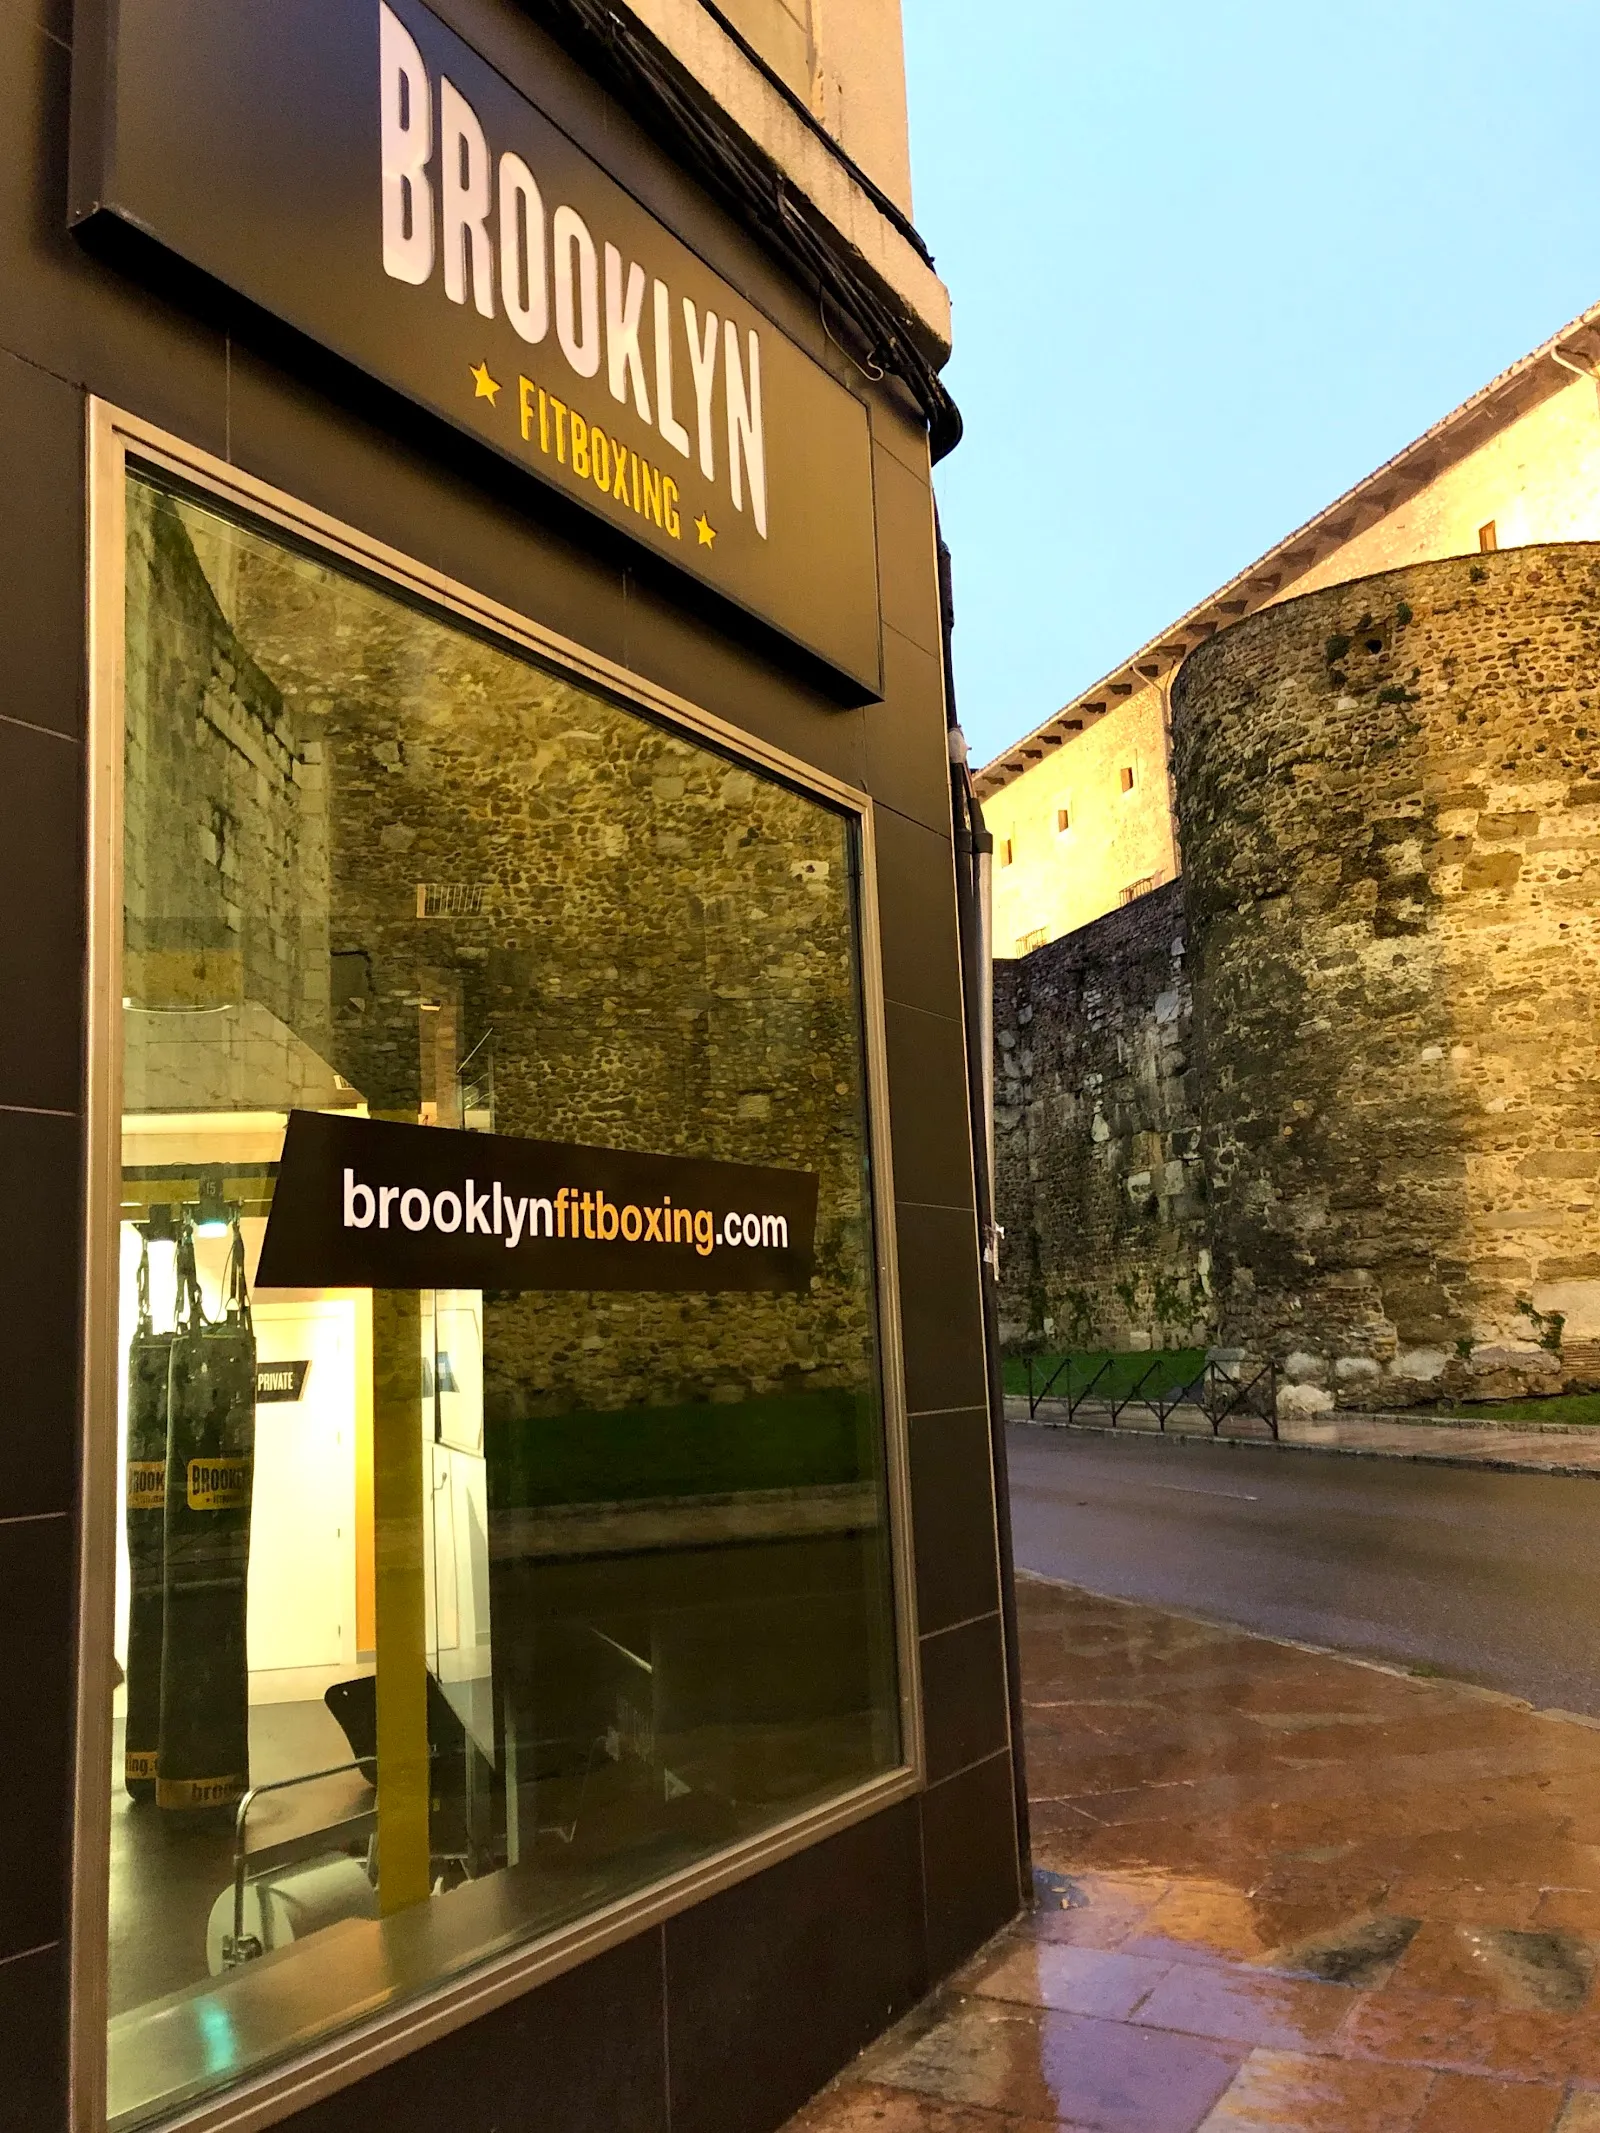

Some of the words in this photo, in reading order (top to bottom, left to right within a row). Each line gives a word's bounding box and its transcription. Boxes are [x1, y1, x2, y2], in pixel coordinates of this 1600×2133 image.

[380, 0, 767, 540] BROOKLYN
[518, 374, 681, 540] FITBOXING
[343, 1168, 789, 1256] brooklynfitboxing.com
[257, 1371, 294, 1391] PRIVATE
